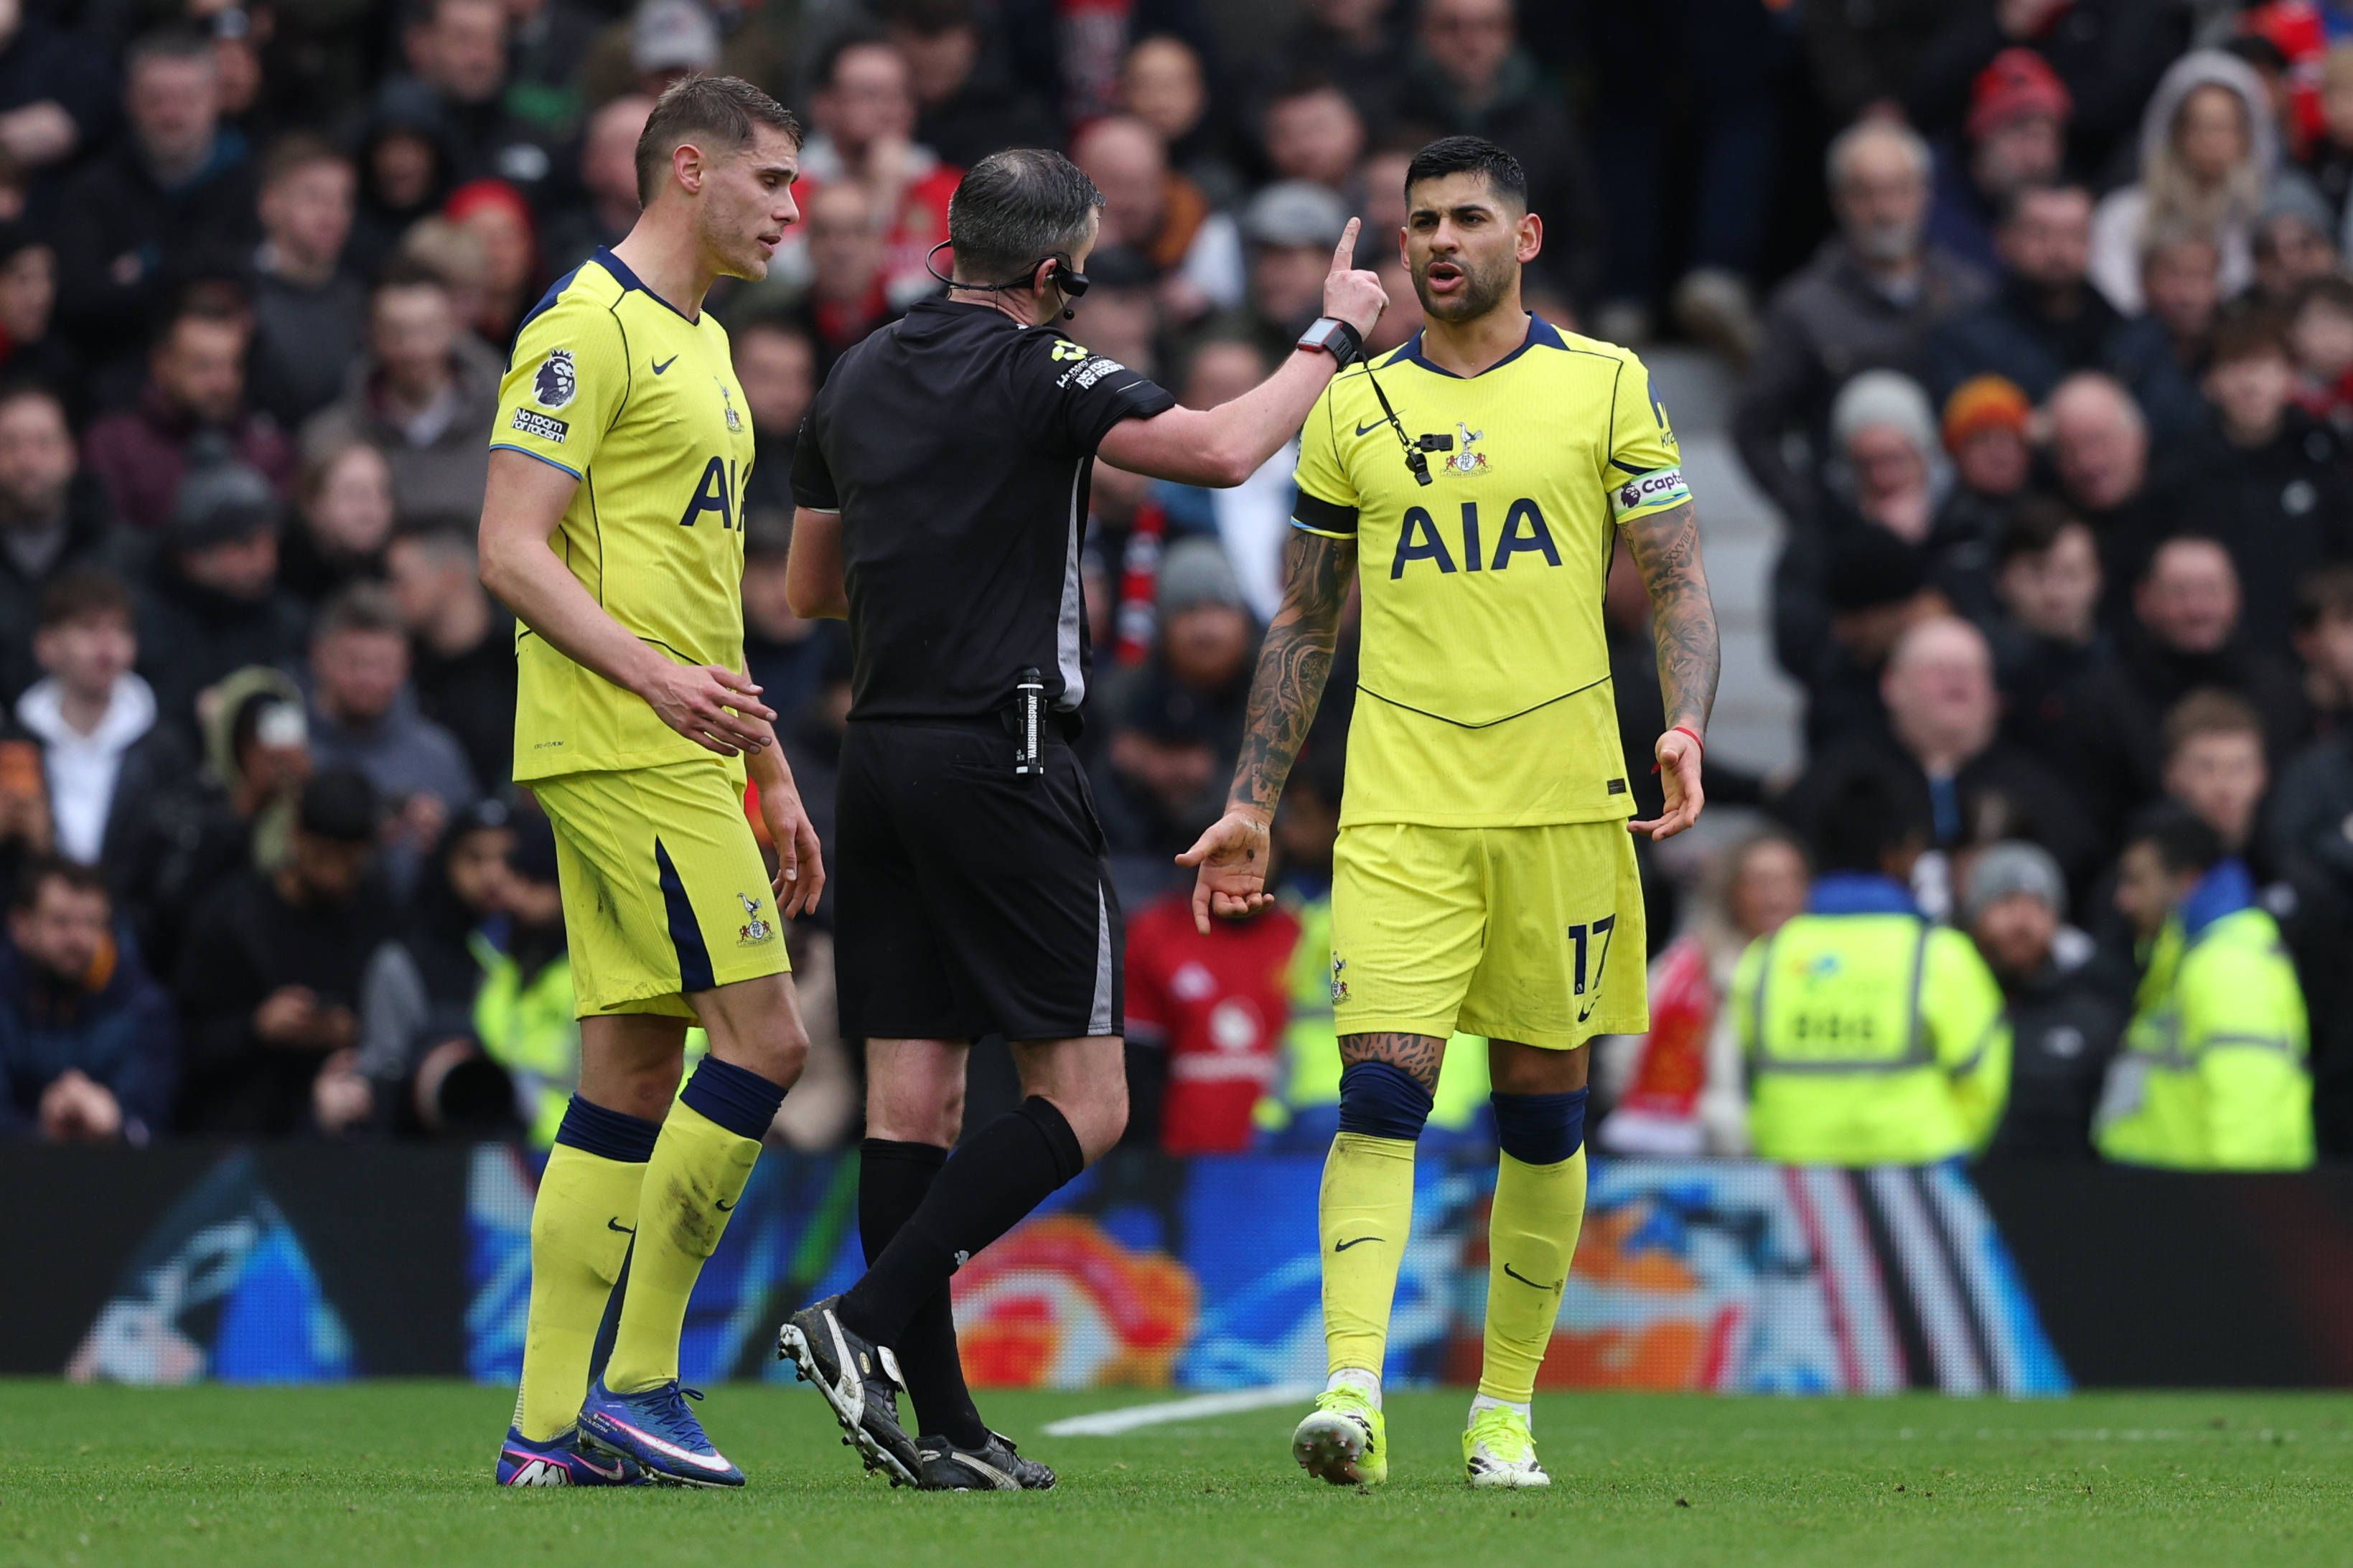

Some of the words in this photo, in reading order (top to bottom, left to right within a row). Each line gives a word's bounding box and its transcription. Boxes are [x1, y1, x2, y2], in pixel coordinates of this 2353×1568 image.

[1075, 370, 1091, 384] No
[511, 418, 528, 430] for
[526, 423, 565, 443] racism
[515, 408, 531, 421] No
[531, 414, 563, 432] room
[1390, 498, 1563, 580] AIA
[1568, 913, 1616, 995] 17
